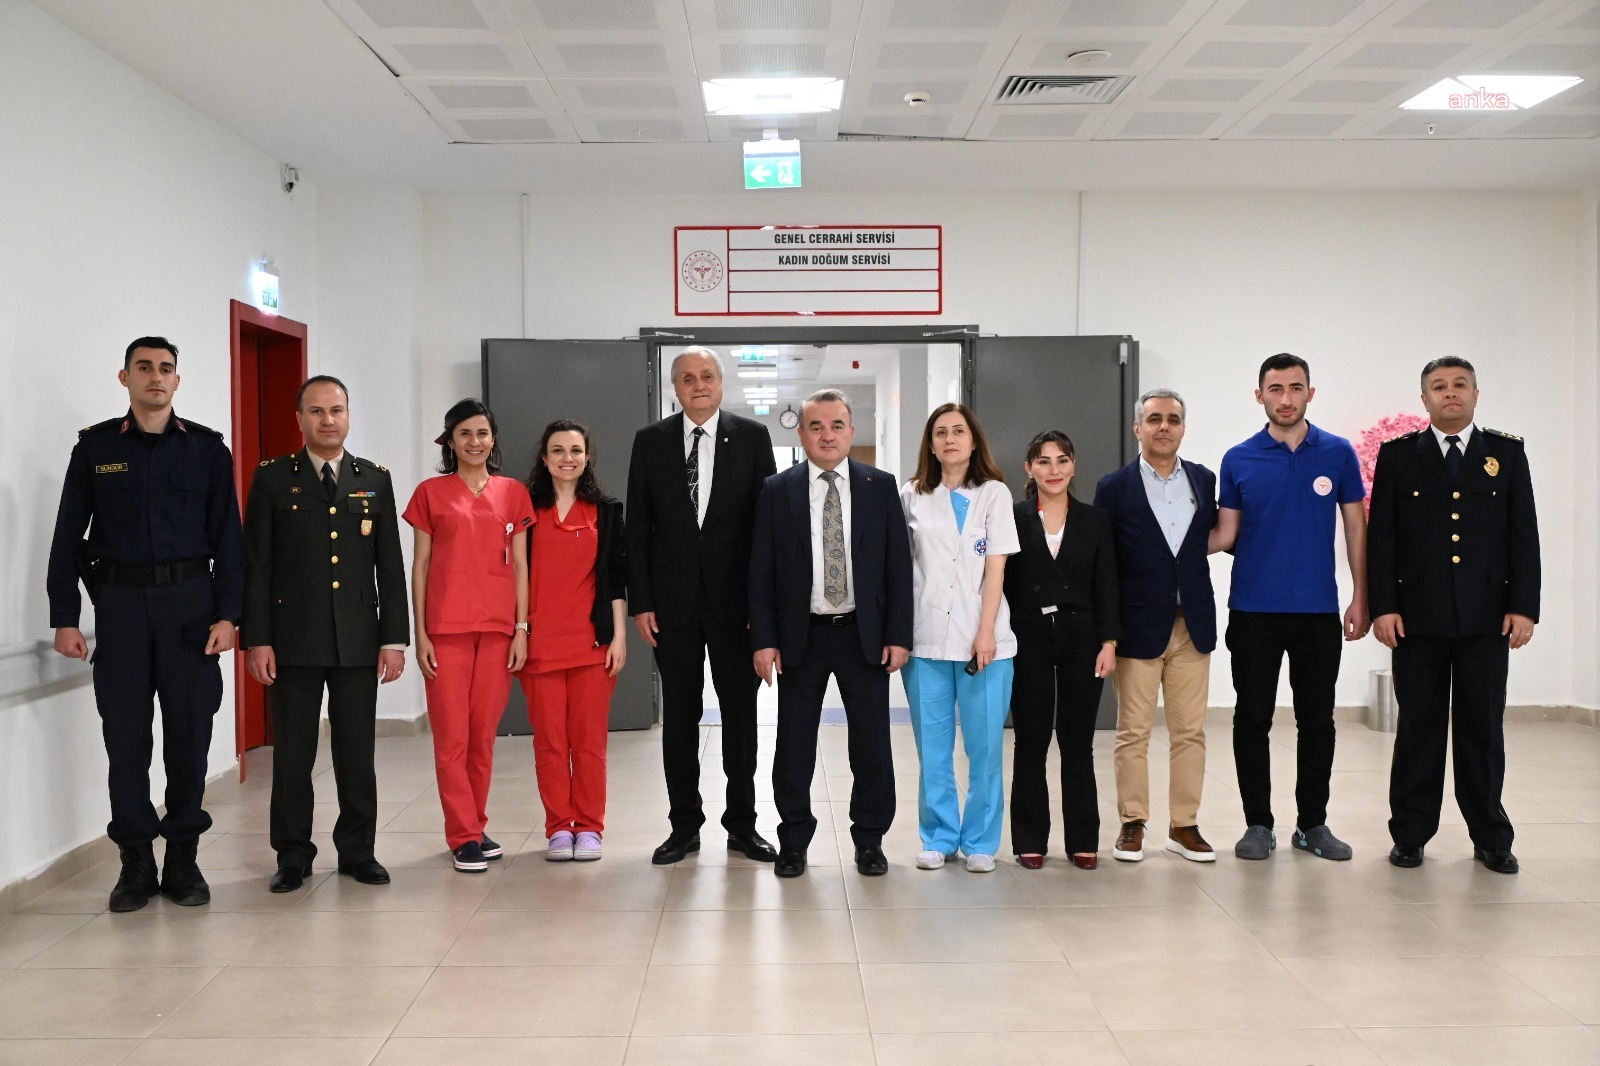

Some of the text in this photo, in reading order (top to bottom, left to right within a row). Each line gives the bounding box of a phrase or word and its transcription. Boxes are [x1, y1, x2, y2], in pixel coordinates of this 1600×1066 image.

[774, 231, 895, 244] GENEL CERRAHİ SERVİSİ
[778, 252, 891, 265] KADIN DOĞUM SERVİSİ
